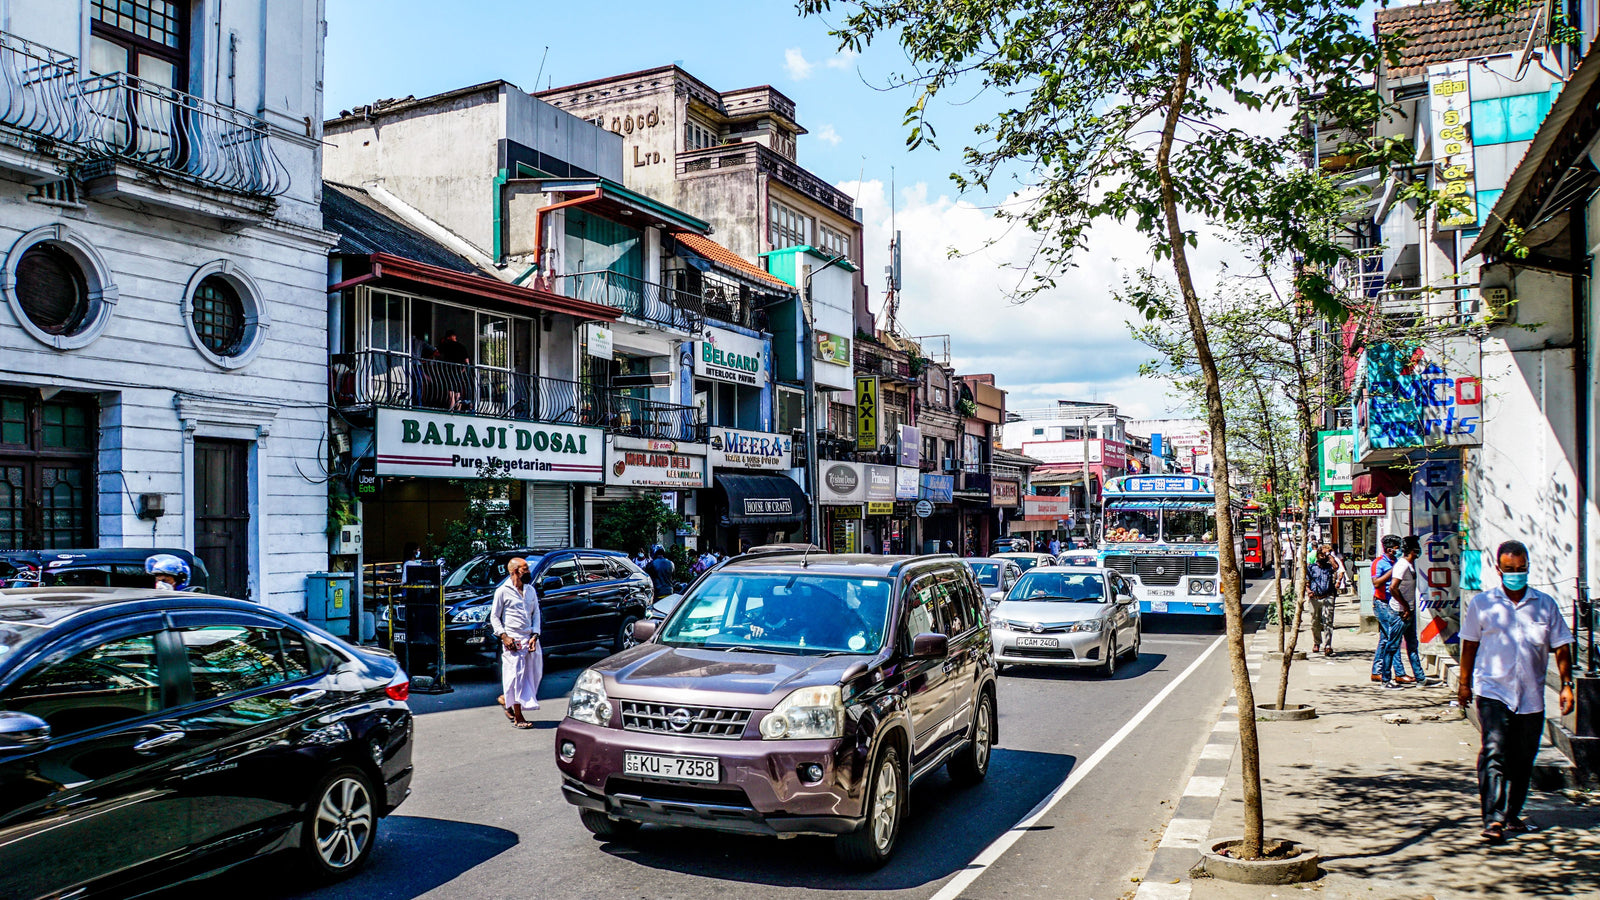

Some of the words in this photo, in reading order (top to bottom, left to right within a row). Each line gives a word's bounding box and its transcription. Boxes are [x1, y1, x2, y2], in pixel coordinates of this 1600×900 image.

[702, 341, 759, 373] BELGARD
[1371, 376, 1481, 408] EMICO
[859, 379, 874, 432] TAXI
[402, 419, 508, 449] BALAJI
[515, 429, 588, 455] DOSAI
[723, 431, 783, 457] MEERA
[451, 454, 482, 469] Pure
[487, 456, 552, 472] Vegetarian
[625, 452, 669, 468] MIDLAND
[671, 456, 691, 469] DELI
[359, 475, 375, 484] Uber
[359, 484, 375, 492] Eats
[746, 501, 764, 512] HOUSE
[771, 501, 791, 512] CRAFTS
[1424, 466, 1452, 588] EMICO
[626, 761, 639, 772] SG
